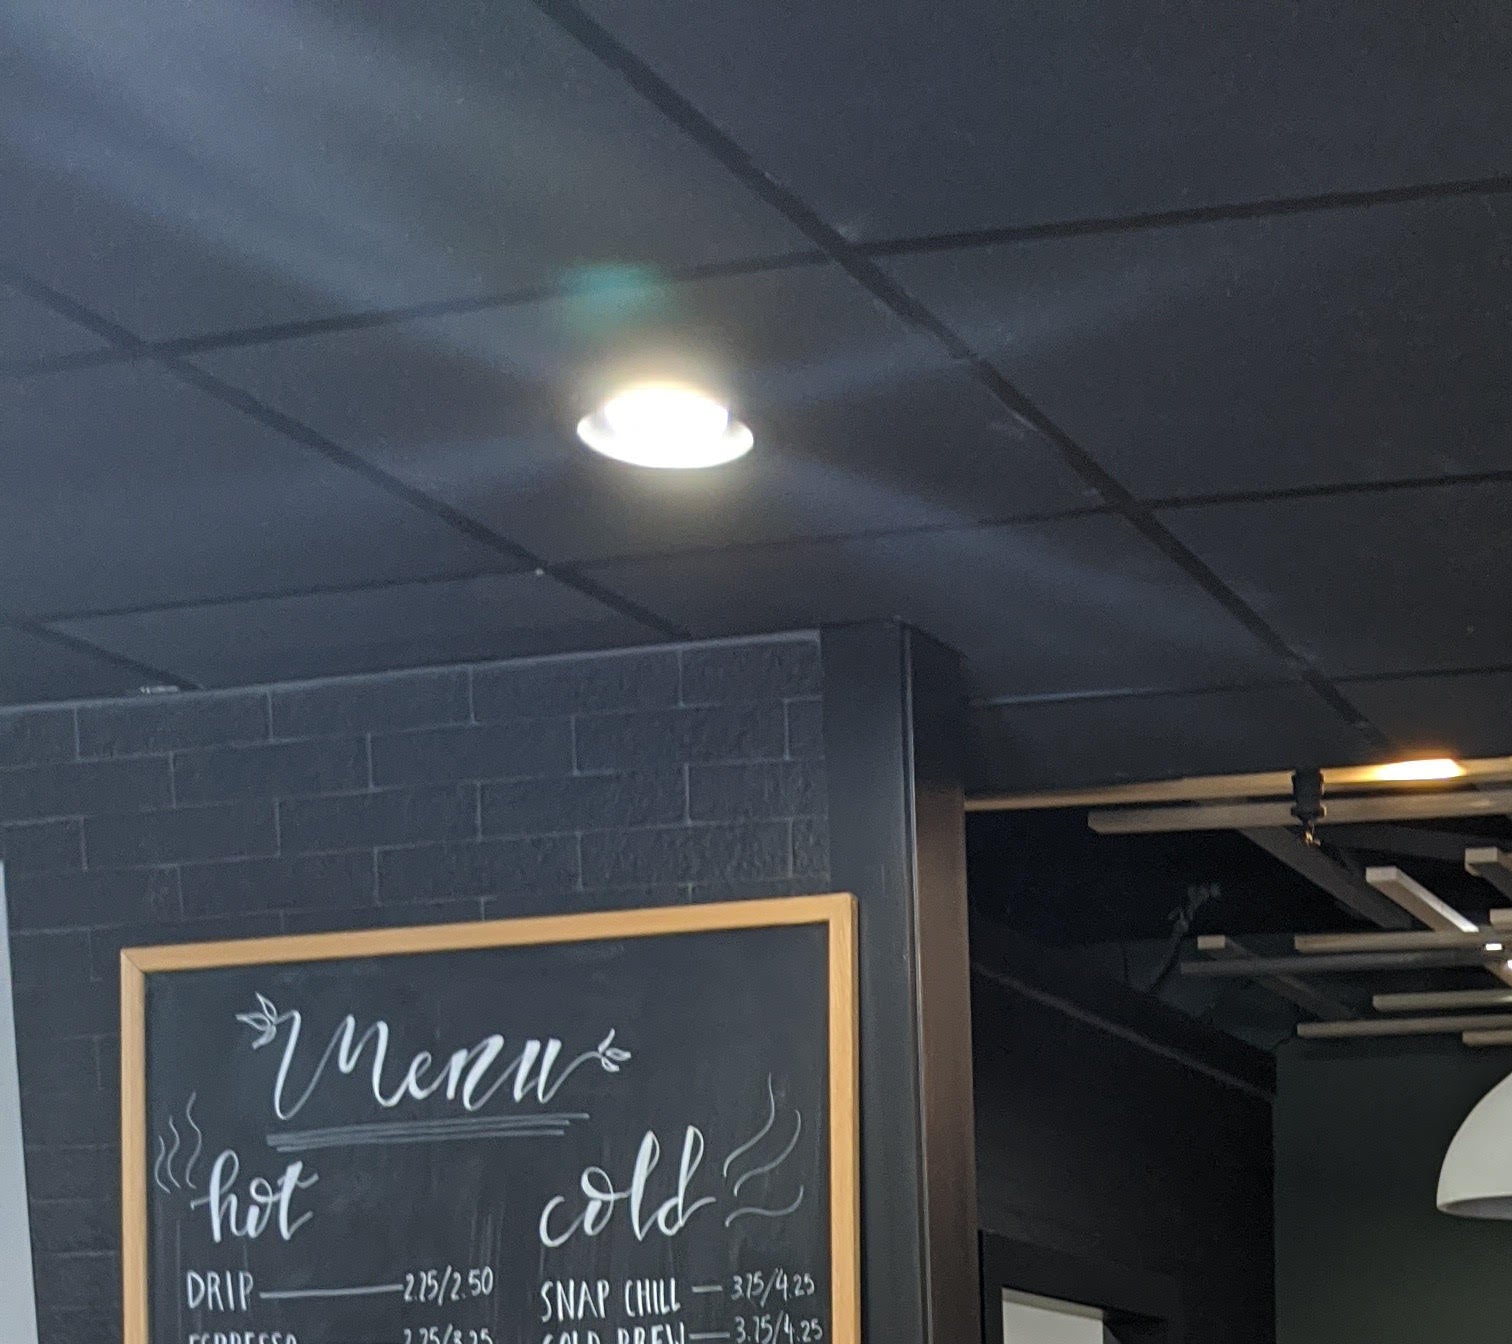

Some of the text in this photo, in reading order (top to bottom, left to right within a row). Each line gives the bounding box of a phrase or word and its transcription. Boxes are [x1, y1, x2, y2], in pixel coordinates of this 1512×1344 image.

[272, 1008, 600, 1120] Menu
[191, 1148, 318, 1243] hot
[539, 1125, 716, 1247] cold
[186, 1270, 253, 1311] DRIP
[540, 1278, 611, 1323] SNAP
[624, 1277, 682, 1317] CHILL
